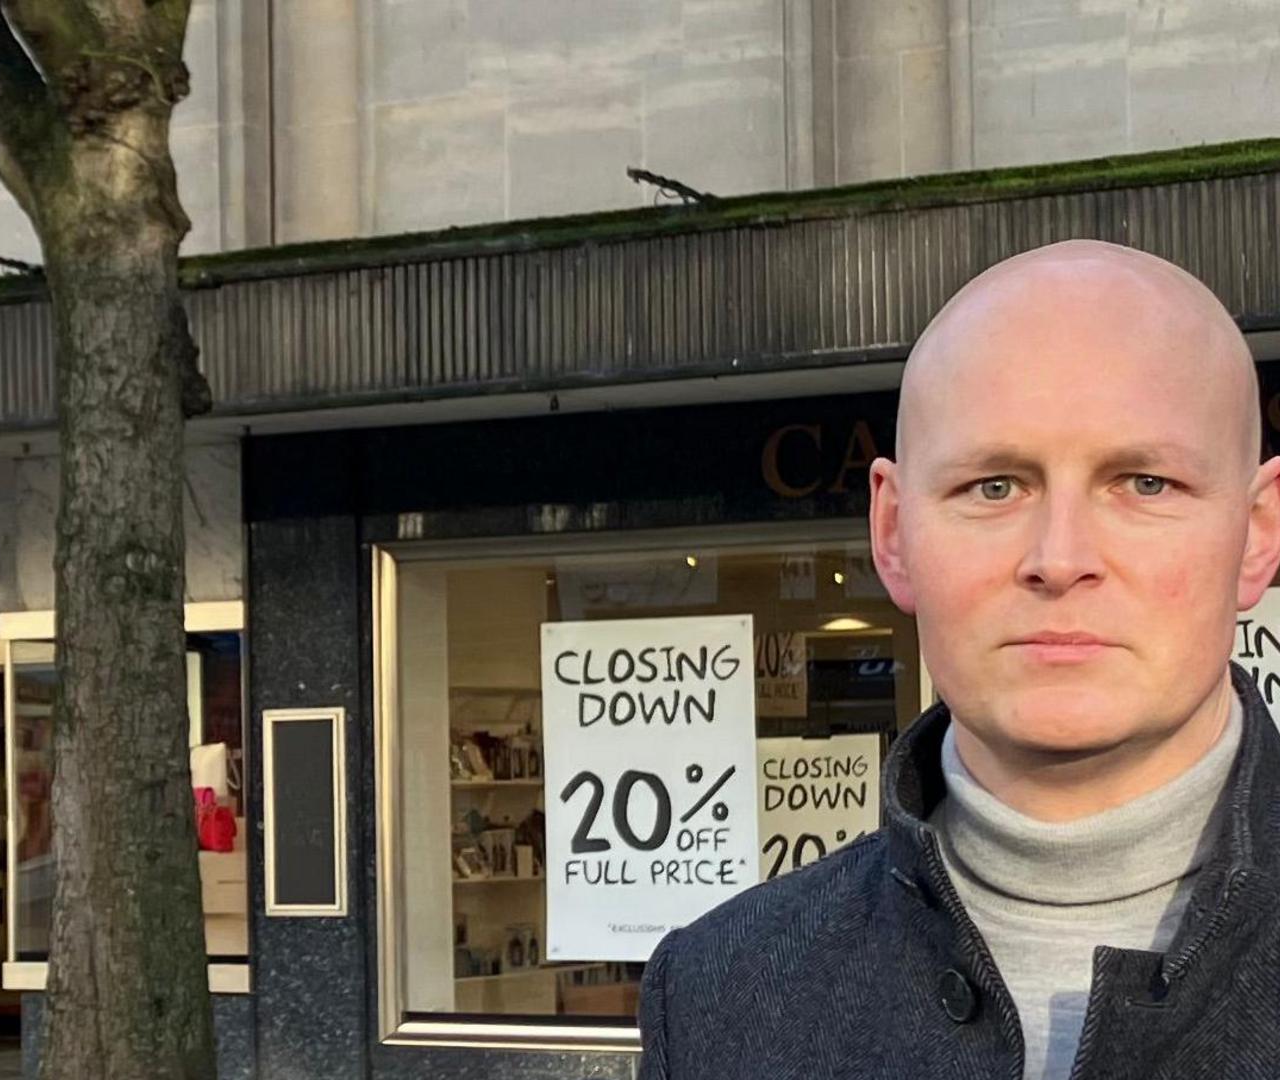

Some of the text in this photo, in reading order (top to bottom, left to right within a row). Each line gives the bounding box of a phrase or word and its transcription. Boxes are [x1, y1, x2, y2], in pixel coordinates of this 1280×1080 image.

[554, 644, 740, 685] CLOSING
[579, 688, 716, 727] DOWN
[763, 755, 868, 780] CLOSING
[559, 763, 736, 854] 20%
[765, 781, 866, 811] DOWN
[676, 828, 730, 851] OFF
[565, 859, 637, 885] FULL
